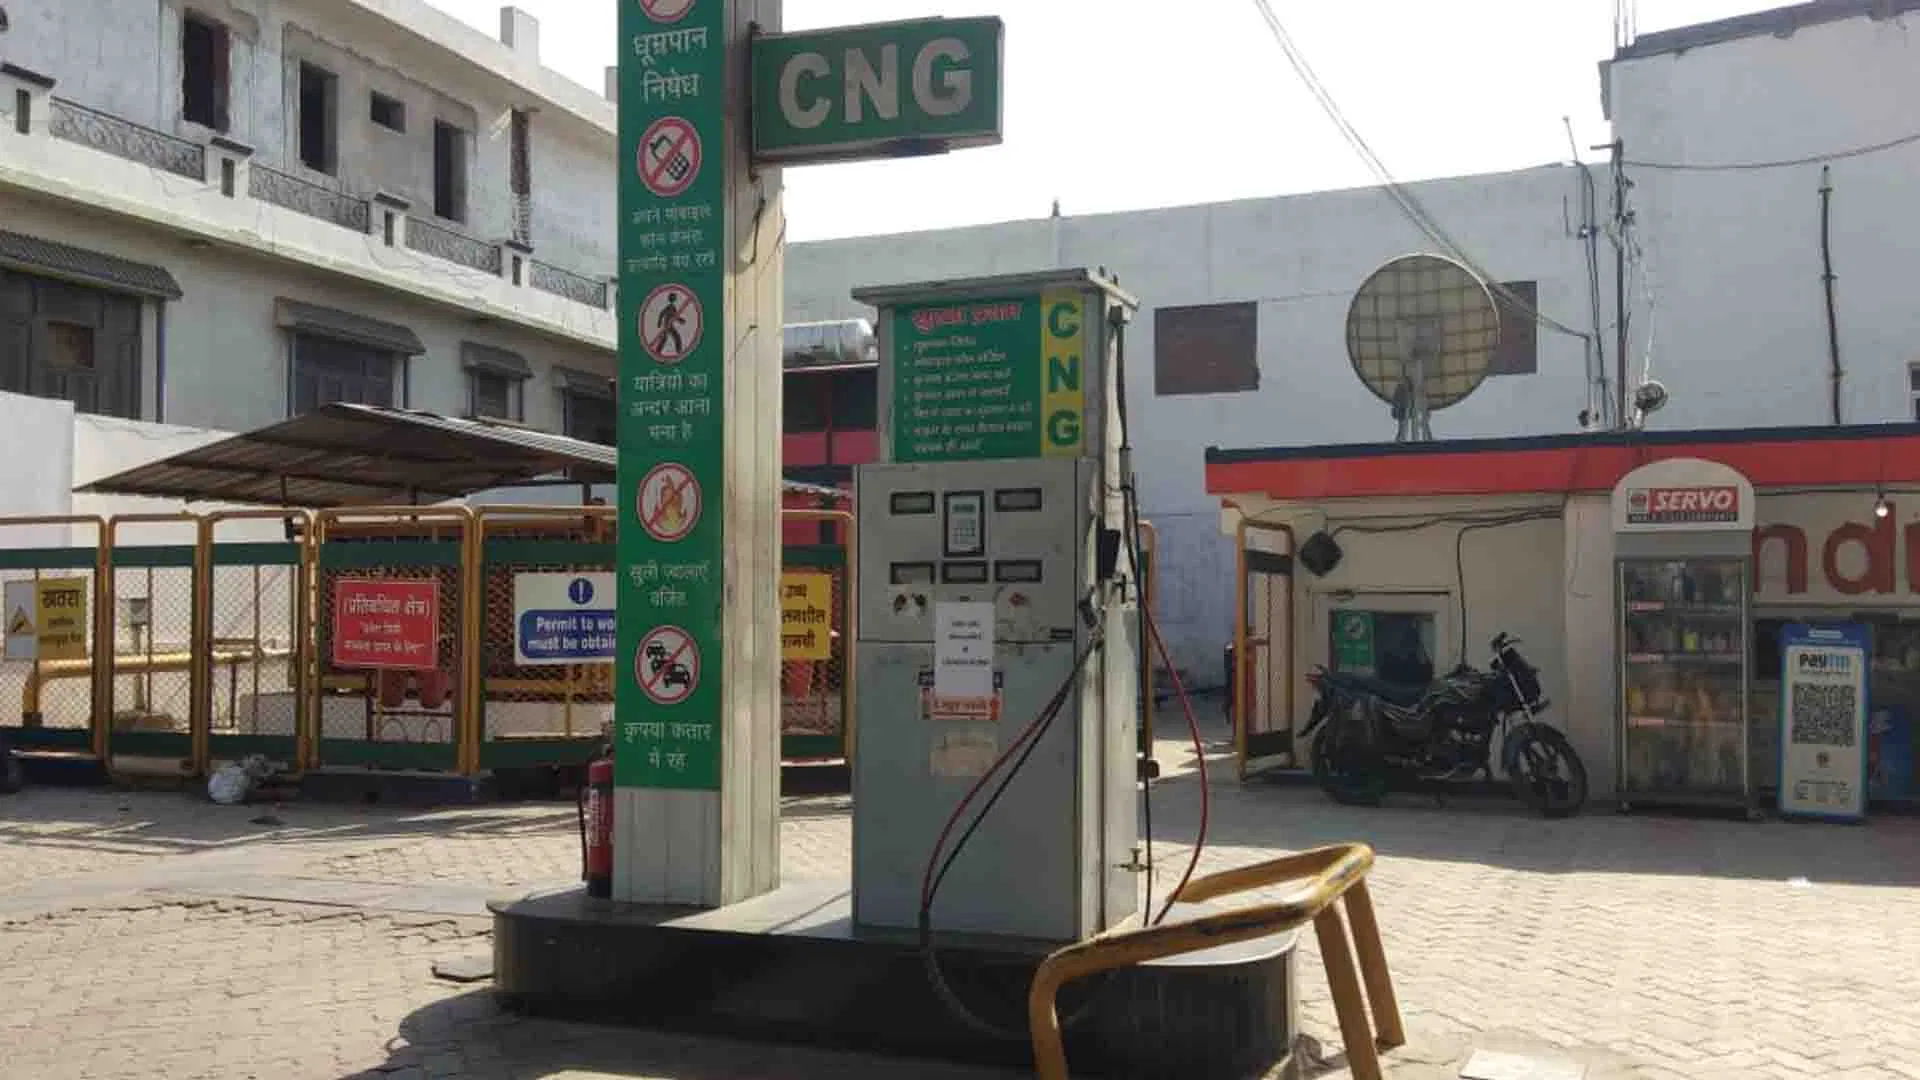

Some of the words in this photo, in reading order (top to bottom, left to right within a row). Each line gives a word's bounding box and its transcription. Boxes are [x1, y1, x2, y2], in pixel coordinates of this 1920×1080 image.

[633, 27, 708, 67] धूम्रपान
[643, 66, 700, 104] निषेध
[779, 38, 973, 129] CNG
[1047, 302, 1080, 446] CNG
[1655, 489, 1734, 511] SERVO
[527, 635, 560, 651] must
[562, 635, 578, 650] be
[536, 615, 577, 633] Permit
[580, 616, 594, 631] to
[597, 617, 616, 632] wo
